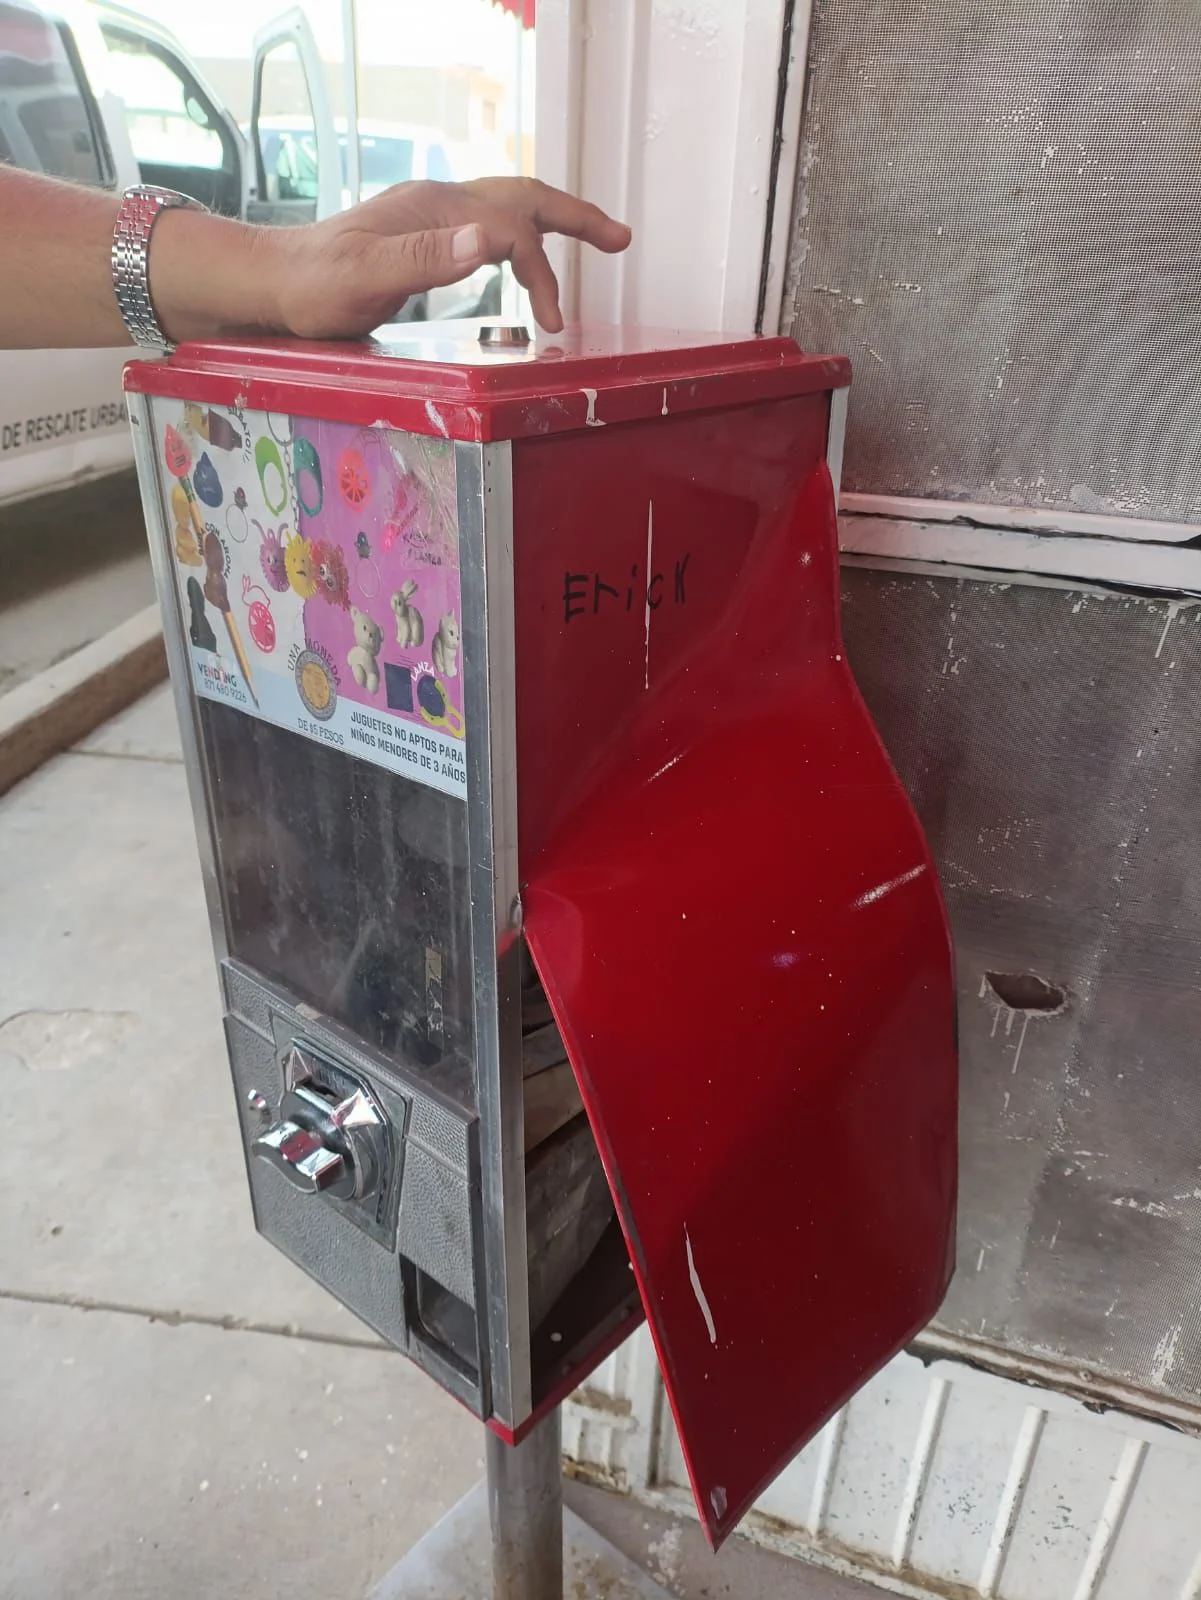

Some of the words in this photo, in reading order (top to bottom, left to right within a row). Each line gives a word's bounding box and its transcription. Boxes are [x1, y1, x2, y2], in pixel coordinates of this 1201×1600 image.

[2, 424, 22, 451] DE
[25, 407, 87, 444] RESCATE
[89, 401, 129, 430] URBA
[287, 643, 301, 672] UNA
[304, 637, 342, 688] MONEDA
[297, 717, 309, 732] DE
[319, 726, 345, 746] PESOS
[350, 711, 393, 736] JUGUETES
[394, 726, 408, 741] NO
[408, 732, 438, 754] APTOS
[438, 743, 465, 765] PARA
[350, 727, 376, 748] NIÑOS
[377, 738, 418, 765] MENORES
[420, 754, 432, 770] DE
[433, 759, 441, 774] 3
[441, 762, 467, 784] AÑOS
